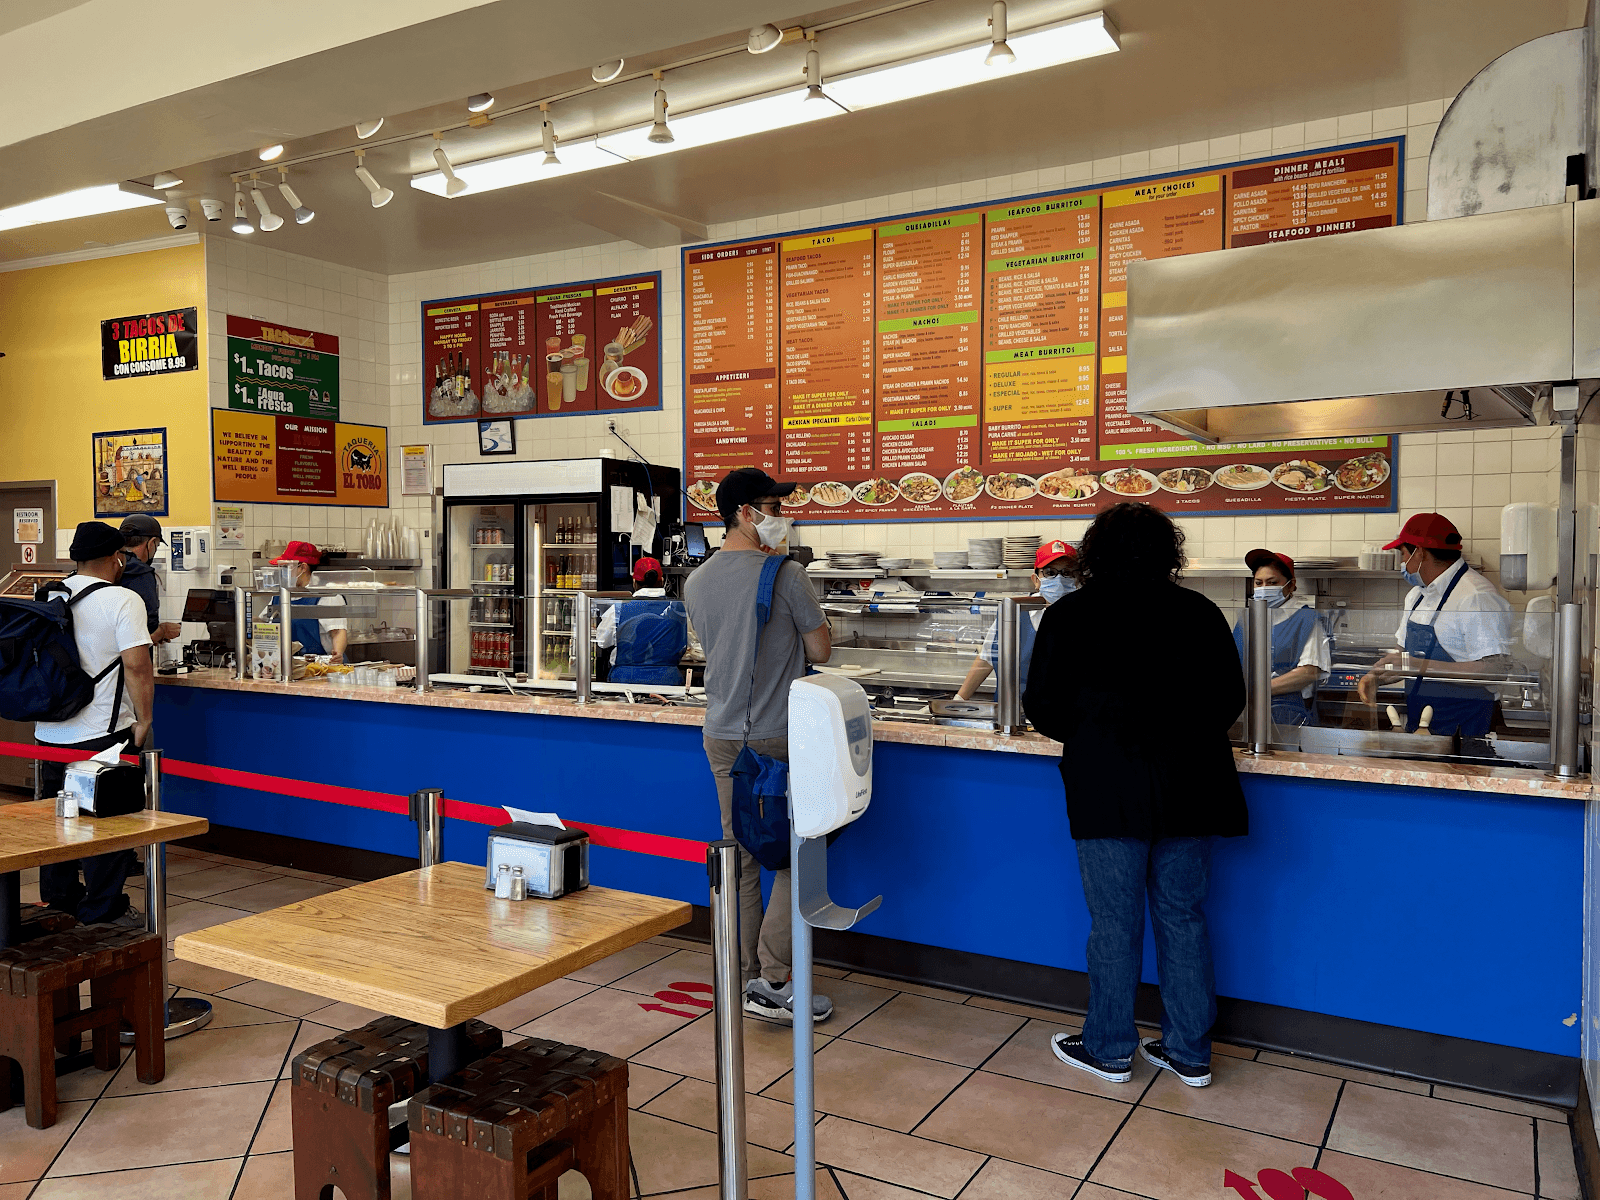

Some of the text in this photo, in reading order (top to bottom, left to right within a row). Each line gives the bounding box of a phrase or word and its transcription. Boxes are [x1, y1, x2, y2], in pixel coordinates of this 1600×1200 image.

[1274, 157, 1345, 176] DINNER MEALS
[1134, 181, 1195, 197] MEAT CHOICES
[1328, 188, 1358, 196] VEGETABLES
[1007, 199, 1083, 217] SEAFOOD BURRITOS
[905, 218, 951, 232] QUESADILLAS
[1248, 214, 1269, 222] CHICKEN
[1268, 227, 1311, 239] SEAFOOD
[1316, 220, 1356, 233] DINNERS
[812, 237, 835, 245] TACOS
[717, 249, 739, 258] ORDERS
[1006, 252, 1084, 268] VEGETARIAN BURRITOS
[112, 312, 185, 340] 3 TACOS DE
[118, 333, 179, 364] BIRRIA
[1039, 347, 1075, 356] BURRITOS
[113, 356, 186, 376] CON CONSOME 8.99
[256, 359, 294, 380] Tacos
[716, 373, 749, 381] APPETIZERS
[261, 387, 284, 402] Agua
[257, 395, 294, 413] Fresca
[235, 432, 258, 440] BELIEVE
[304, 425, 327, 434] MISSION
[219, 440, 256, 448] SUPPORTING
[342, 437, 379, 456] TAQUERIA
[1283, 438, 1337, 446] PRESERVATIVES
[342, 472, 382, 490] EL TORO
